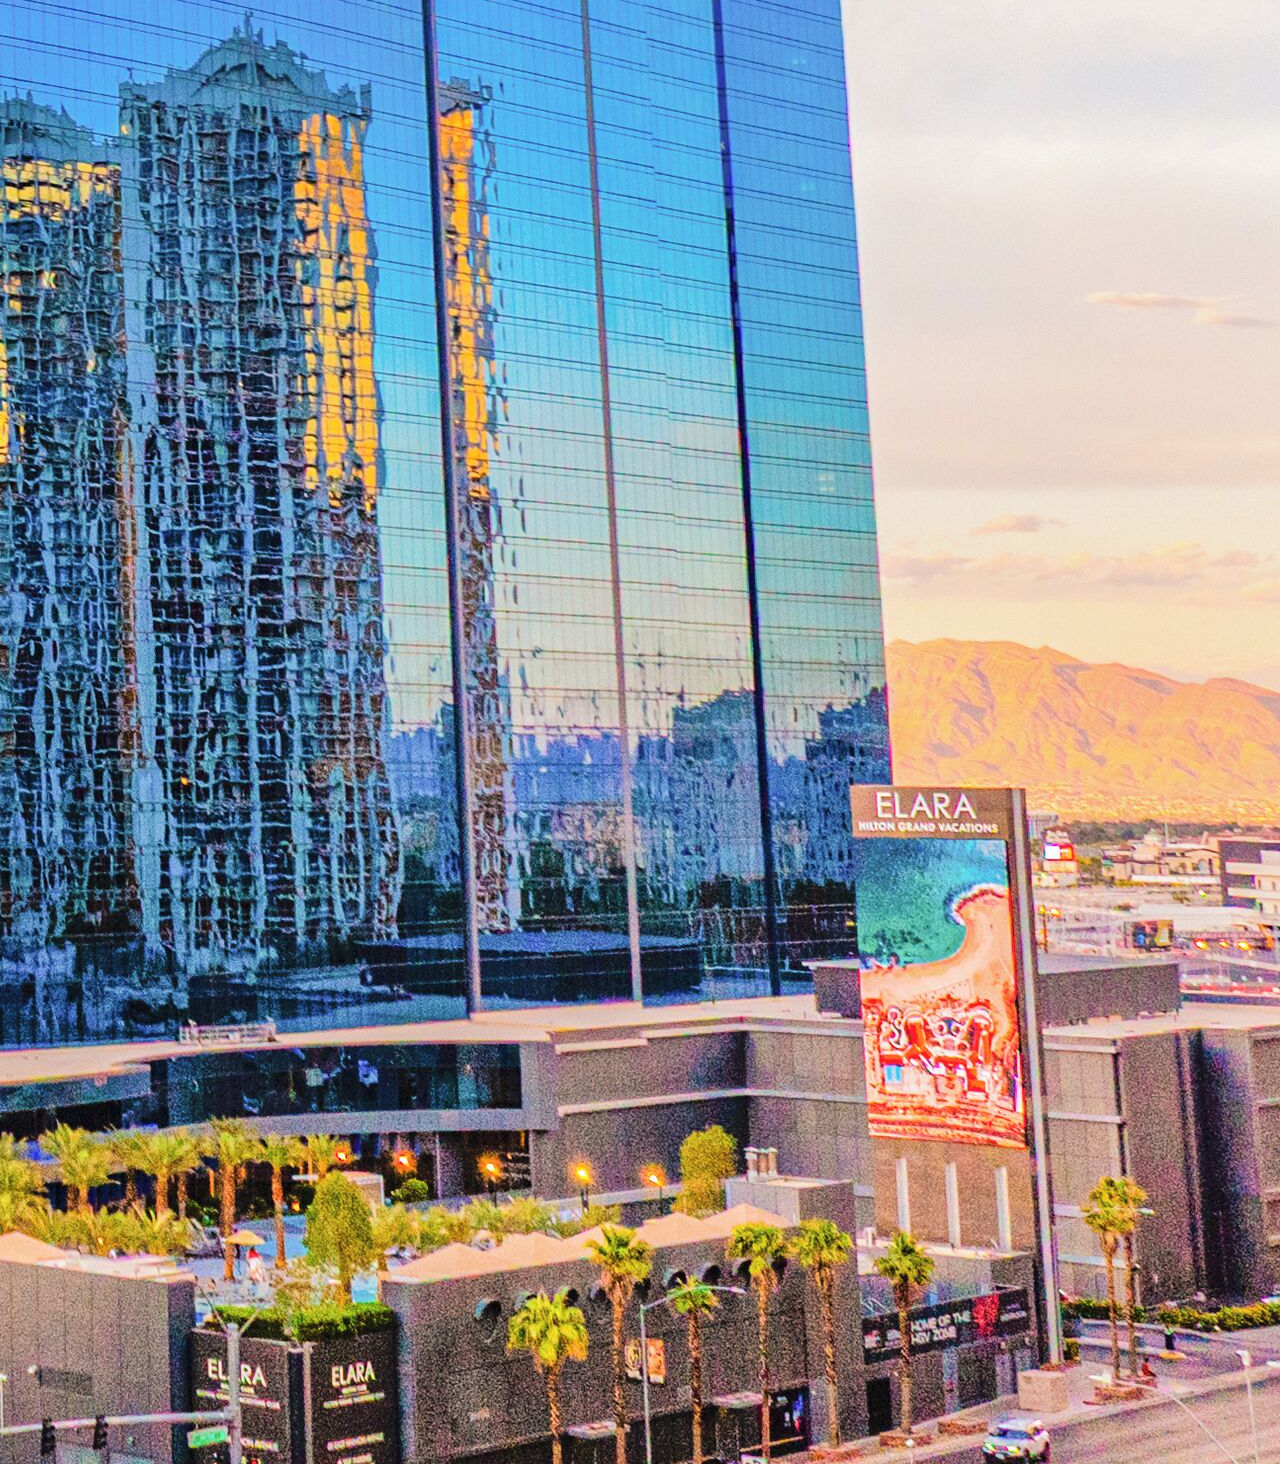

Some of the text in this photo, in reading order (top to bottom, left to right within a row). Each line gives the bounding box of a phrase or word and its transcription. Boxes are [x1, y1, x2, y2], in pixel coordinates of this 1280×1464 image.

[875, 791, 978, 819] ELARA
[858, 821, 999, 834] HILTON GRAND VACATIONS
[207, 1357, 267, 1388] ELRA
[331, 1360, 377, 1388] ELARA
